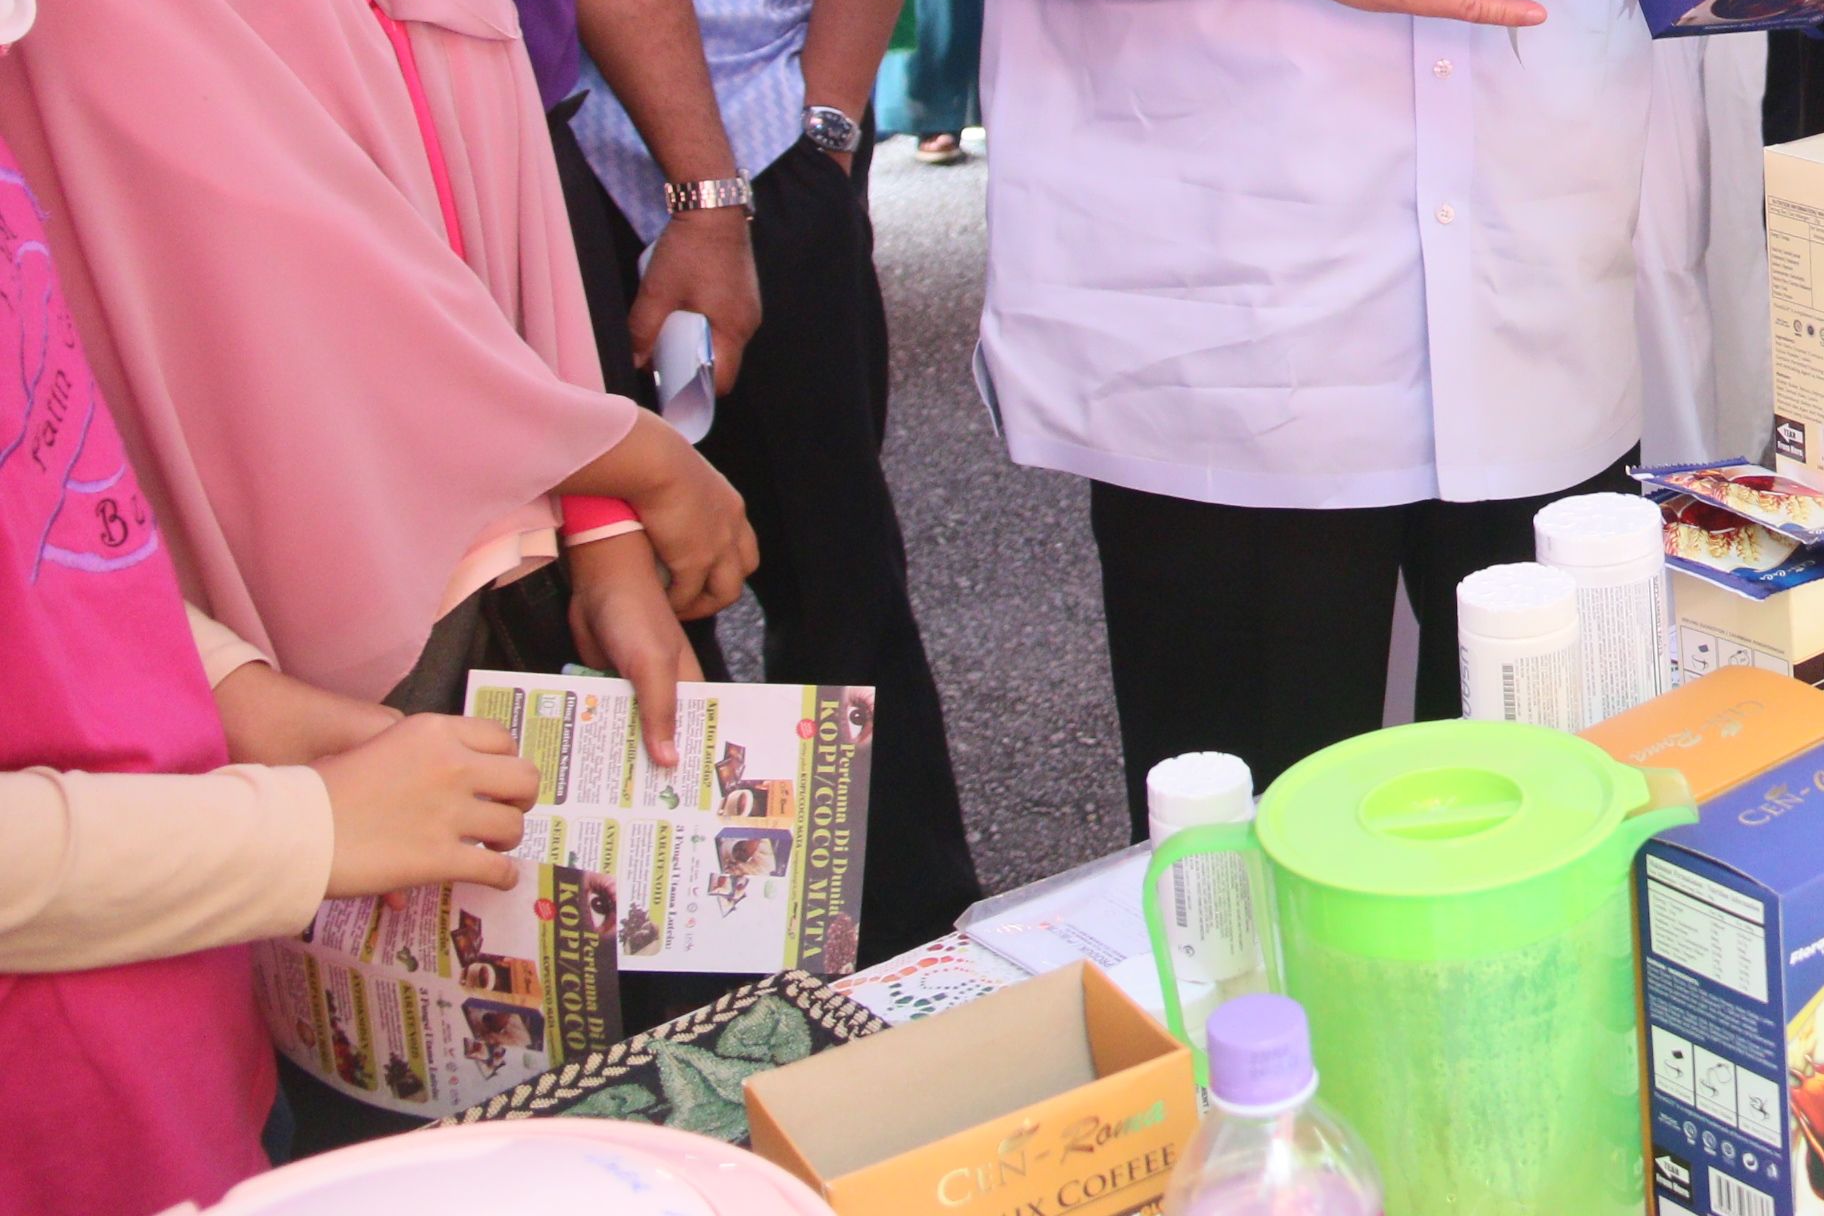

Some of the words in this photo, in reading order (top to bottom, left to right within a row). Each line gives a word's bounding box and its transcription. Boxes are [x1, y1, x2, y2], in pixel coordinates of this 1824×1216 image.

[708, 702, 717, 720] Apa
[562, 724, 573, 754] Lutein
[627, 739, 636, 762] pilih
[708, 725, 716, 740] Itu
[557, 756, 568, 796] Seharian
[703, 745, 714, 787] Lutein?
[810, 700, 838, 868] KOPI/COCO
[836, 743, 856, 823] Pertama
[796, 773, 806, 823] KOPI/COCO
[551, 821, 562, 860] SERAP
[603, 826, 617, 874] ANTIOK
[671, 836, 683, 870] Fungsi
[795, 826, 803, 848] MATA
[833, 830, 850, 852] Di
[669, 874, 680, 907] Utama
[829, 858, 846, 916] Dunia
[802, 878, 826, 958] MATA
[558, 881, 585, 1050] KOPI/COCO
[583, 932, 600, 1011] Pertama
[588, 1017, 605, 1038] Di
[1057, 1143, 1176, 1208] COFFEE
